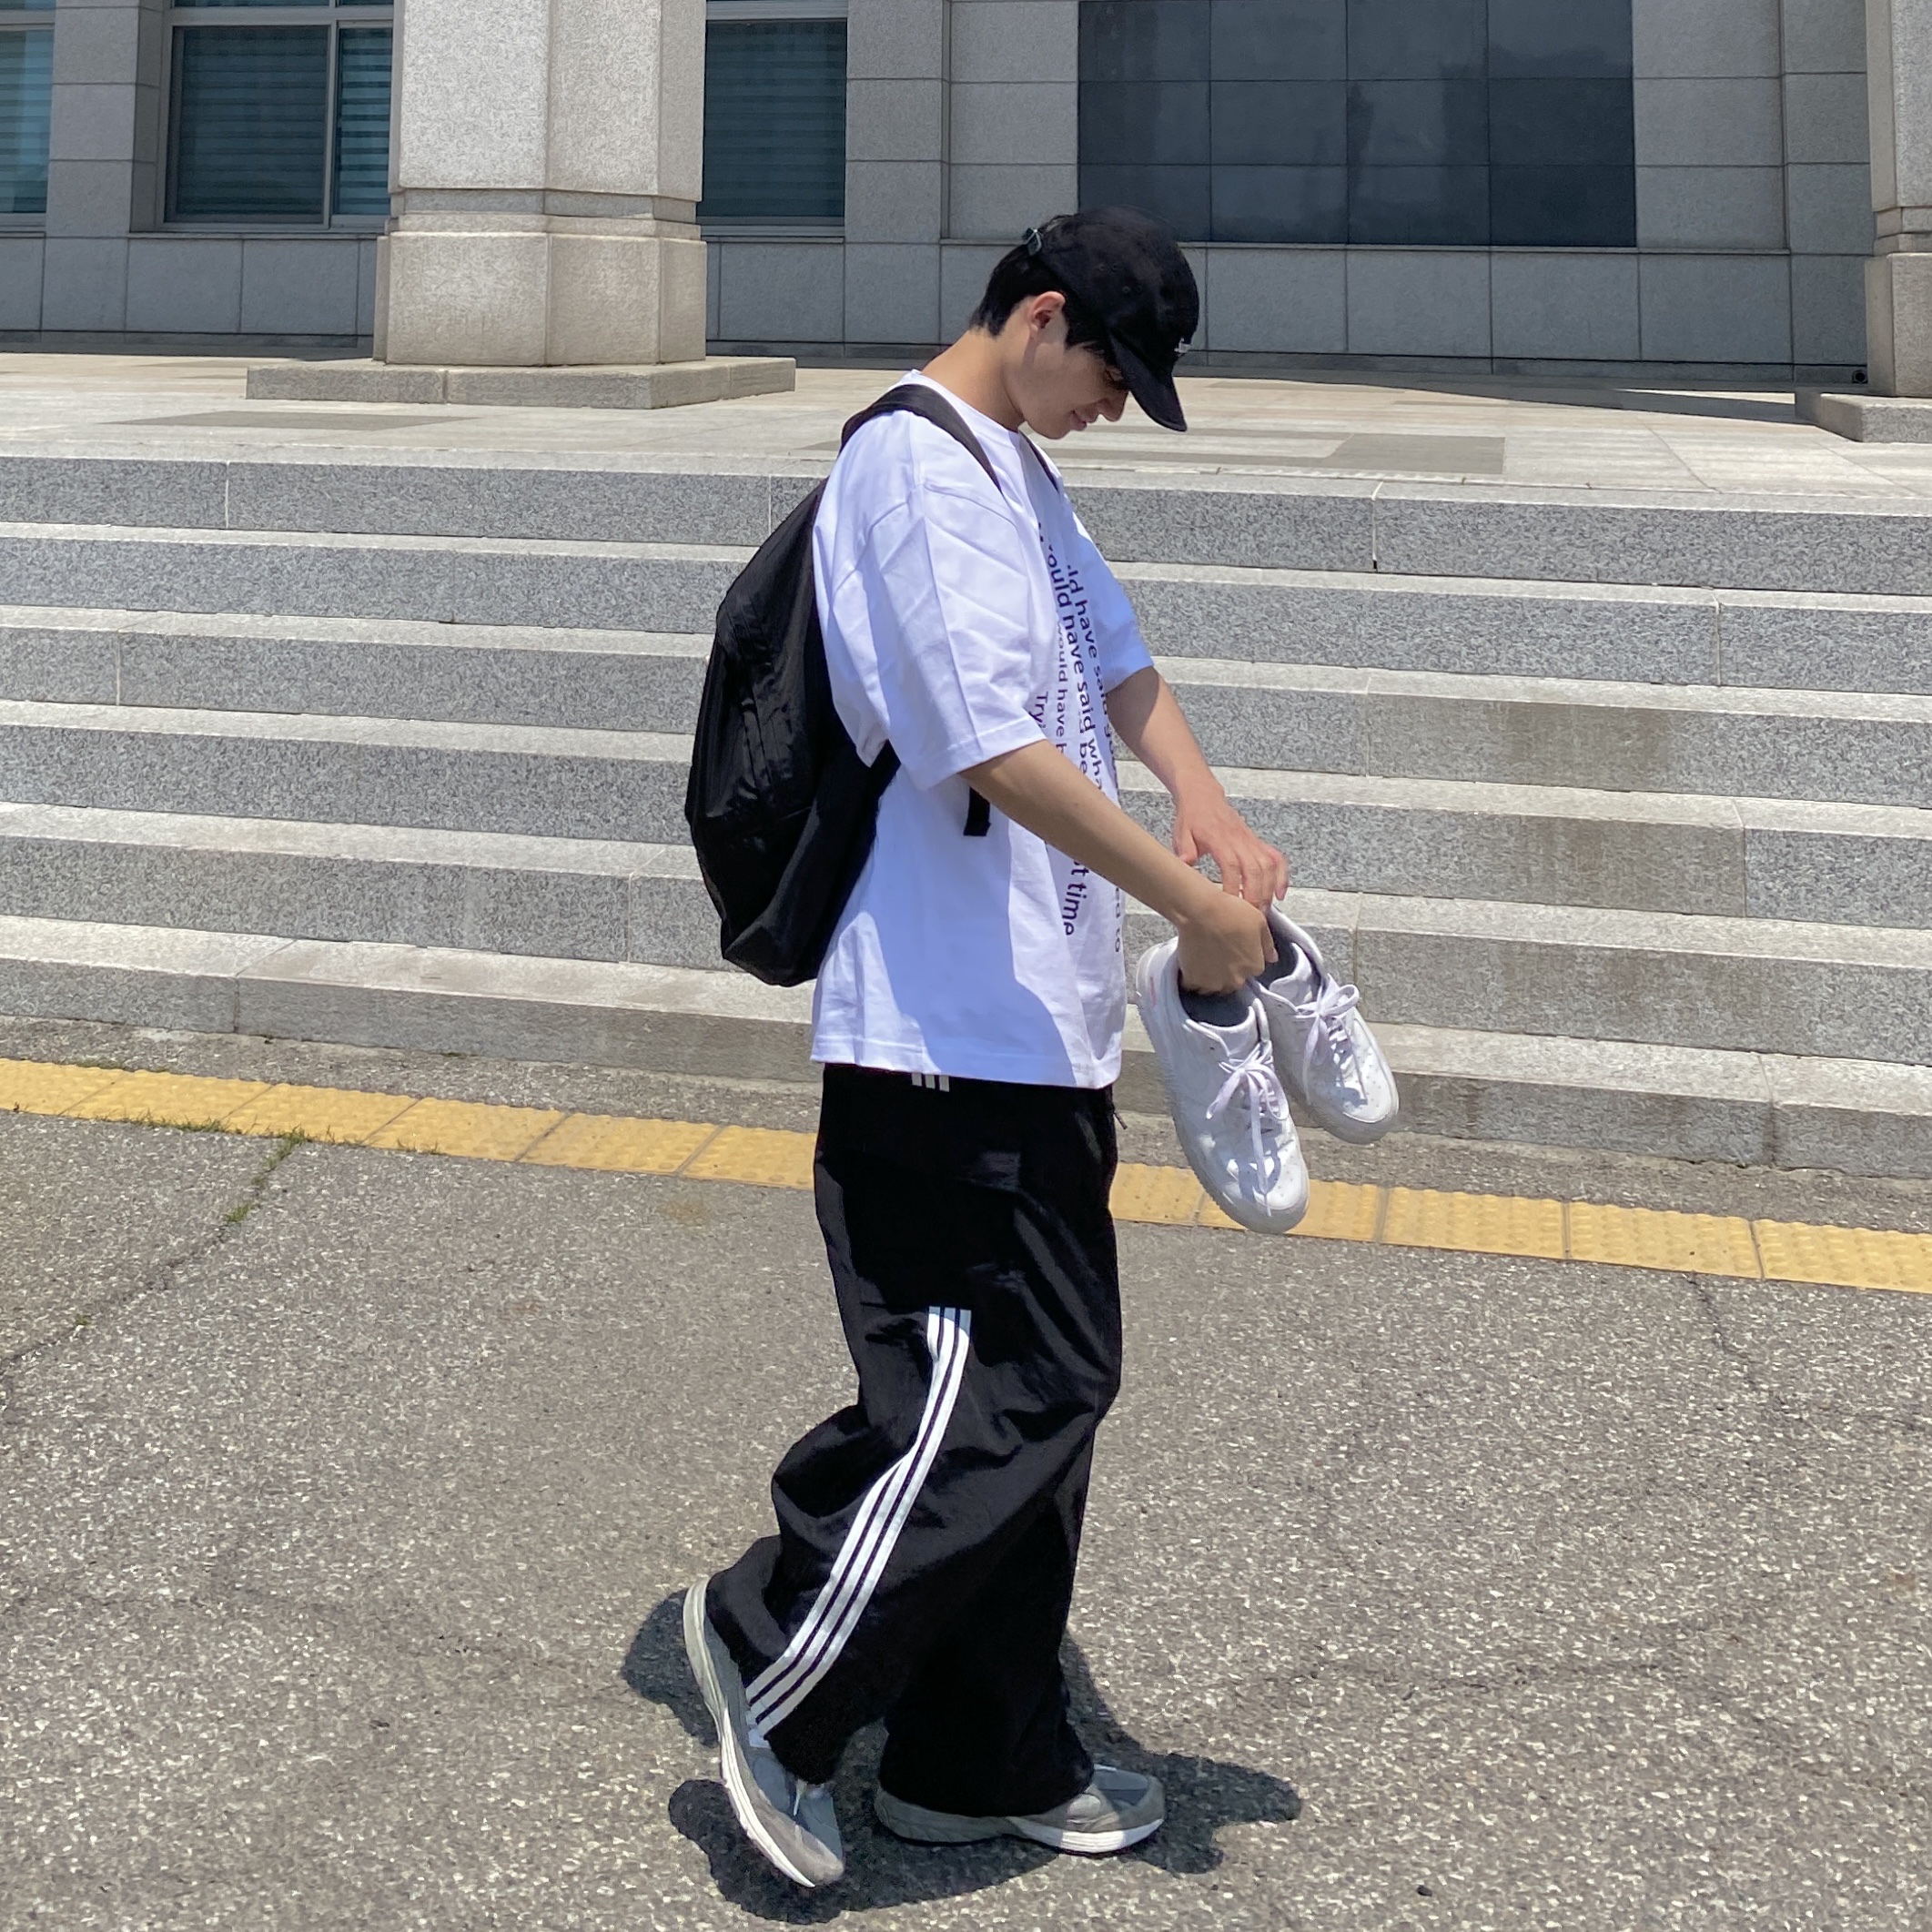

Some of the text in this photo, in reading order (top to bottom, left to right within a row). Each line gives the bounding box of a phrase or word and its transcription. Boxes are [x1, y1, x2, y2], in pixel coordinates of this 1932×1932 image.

[1075, 599, 1097, 659] have
[1056, 688, 1068, 737] have
[1077, 681, 1097, 732] said
[1062, 882, 1087, 936] time
